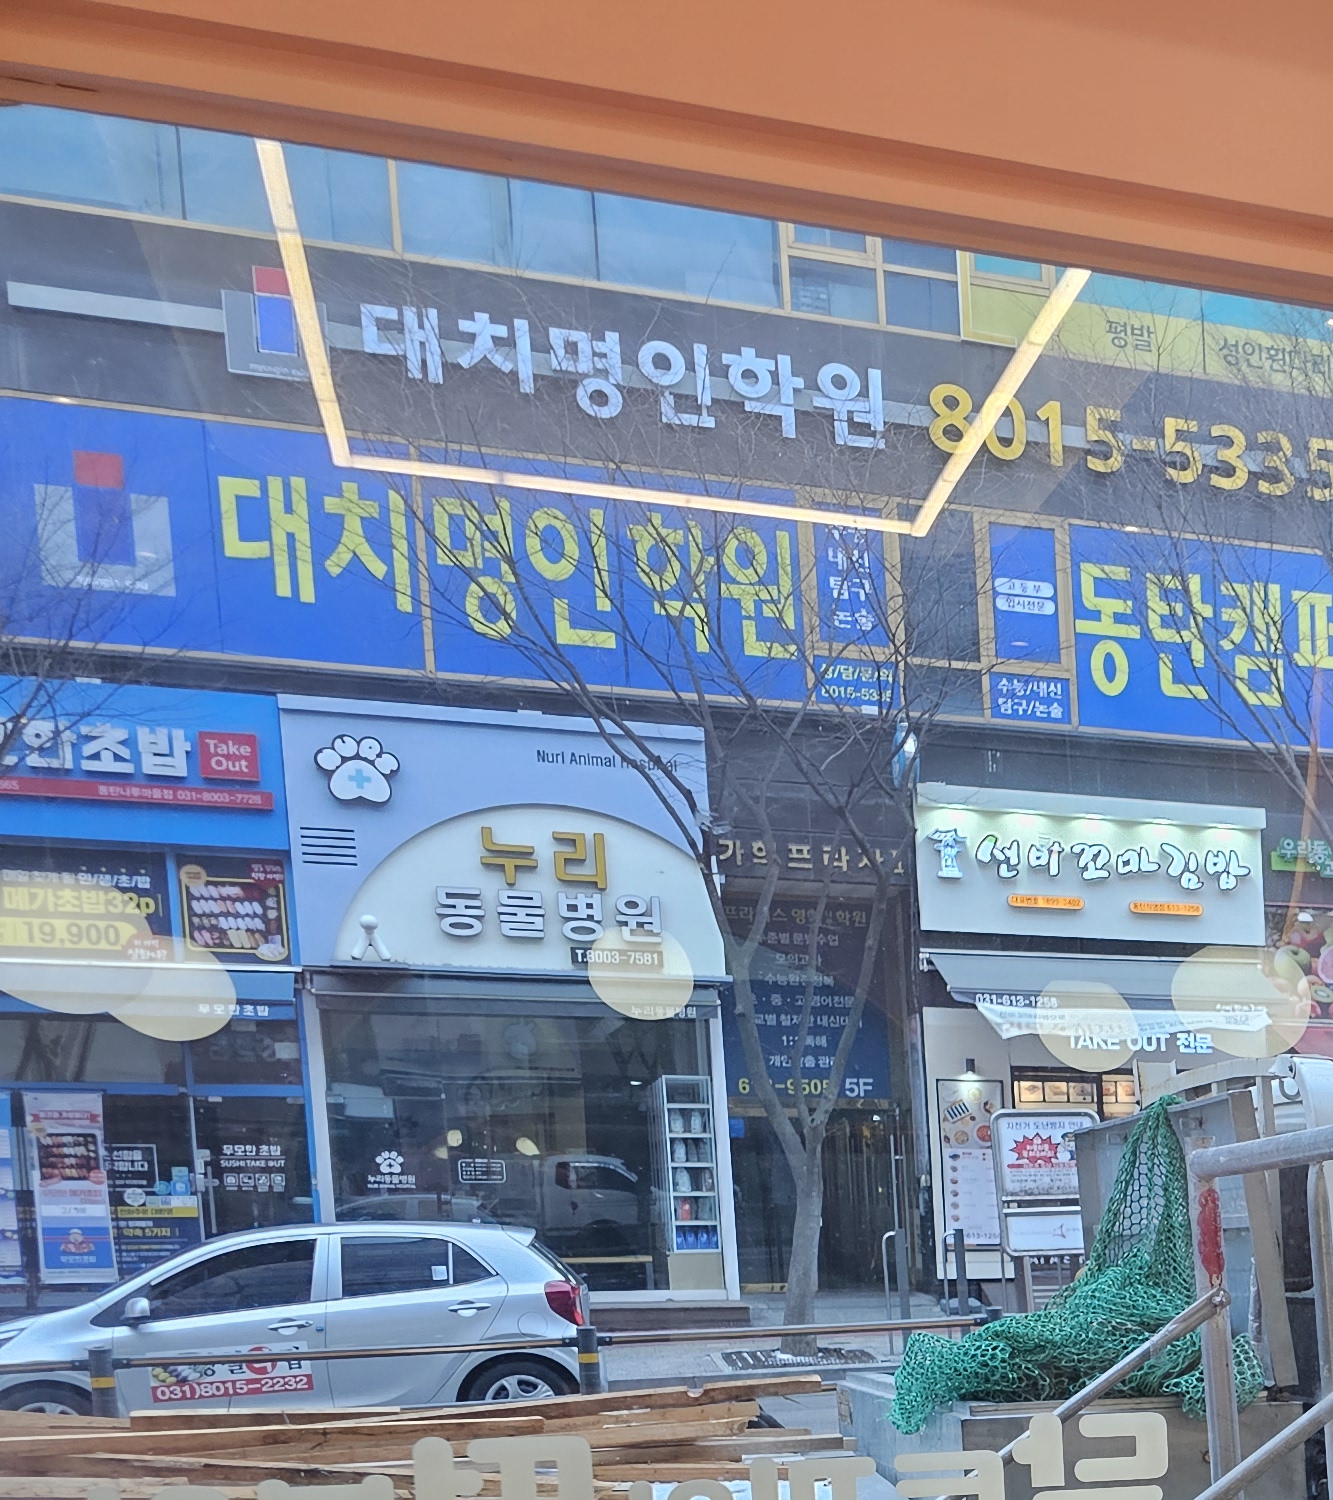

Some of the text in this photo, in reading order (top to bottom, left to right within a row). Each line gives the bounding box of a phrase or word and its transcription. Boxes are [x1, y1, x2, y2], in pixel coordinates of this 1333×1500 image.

[1106, 320, 1154, 353] 평발
[360, 302, 886, 450] 대치명인학원
[217, 476, 798, 660] 대치명인학원
[998, 678, 1062, 700] 수능/내신
[998, 698, 1063, 719] 탐구/논술
[204, 738, 252, 756] Take
[210, 756, 249, 773] Out
[537, 750, 678, 772] Nuri Animal Hspal
[480, 827, 607, 889] 누리
[975, 834, 1250, 890] 선비꼬마김밥
[435, 886, 664, 943] 동물병원
[22, 921, 121, 946] 19,900
[576, 949, 659, 966] T.8003-7581
[198, 1003, 270, 1017] 무모한초밥
[630, 1005, 697, 1018] 누리동물병원
[975, 994, 1058, 1008] 031-613-1258
[1069, 1032, 1214, 1054] TAKE OUT 전문
[845, 1078, 874, 1097] 5F
[222, 1145, 281, 1156] 무모한 초밥
[220, 1159, 246, 1168] SUSHI
[246, 1159, 266, 1168] TAKE
[156, 1376, 309, 1401] 031)8015-2232
